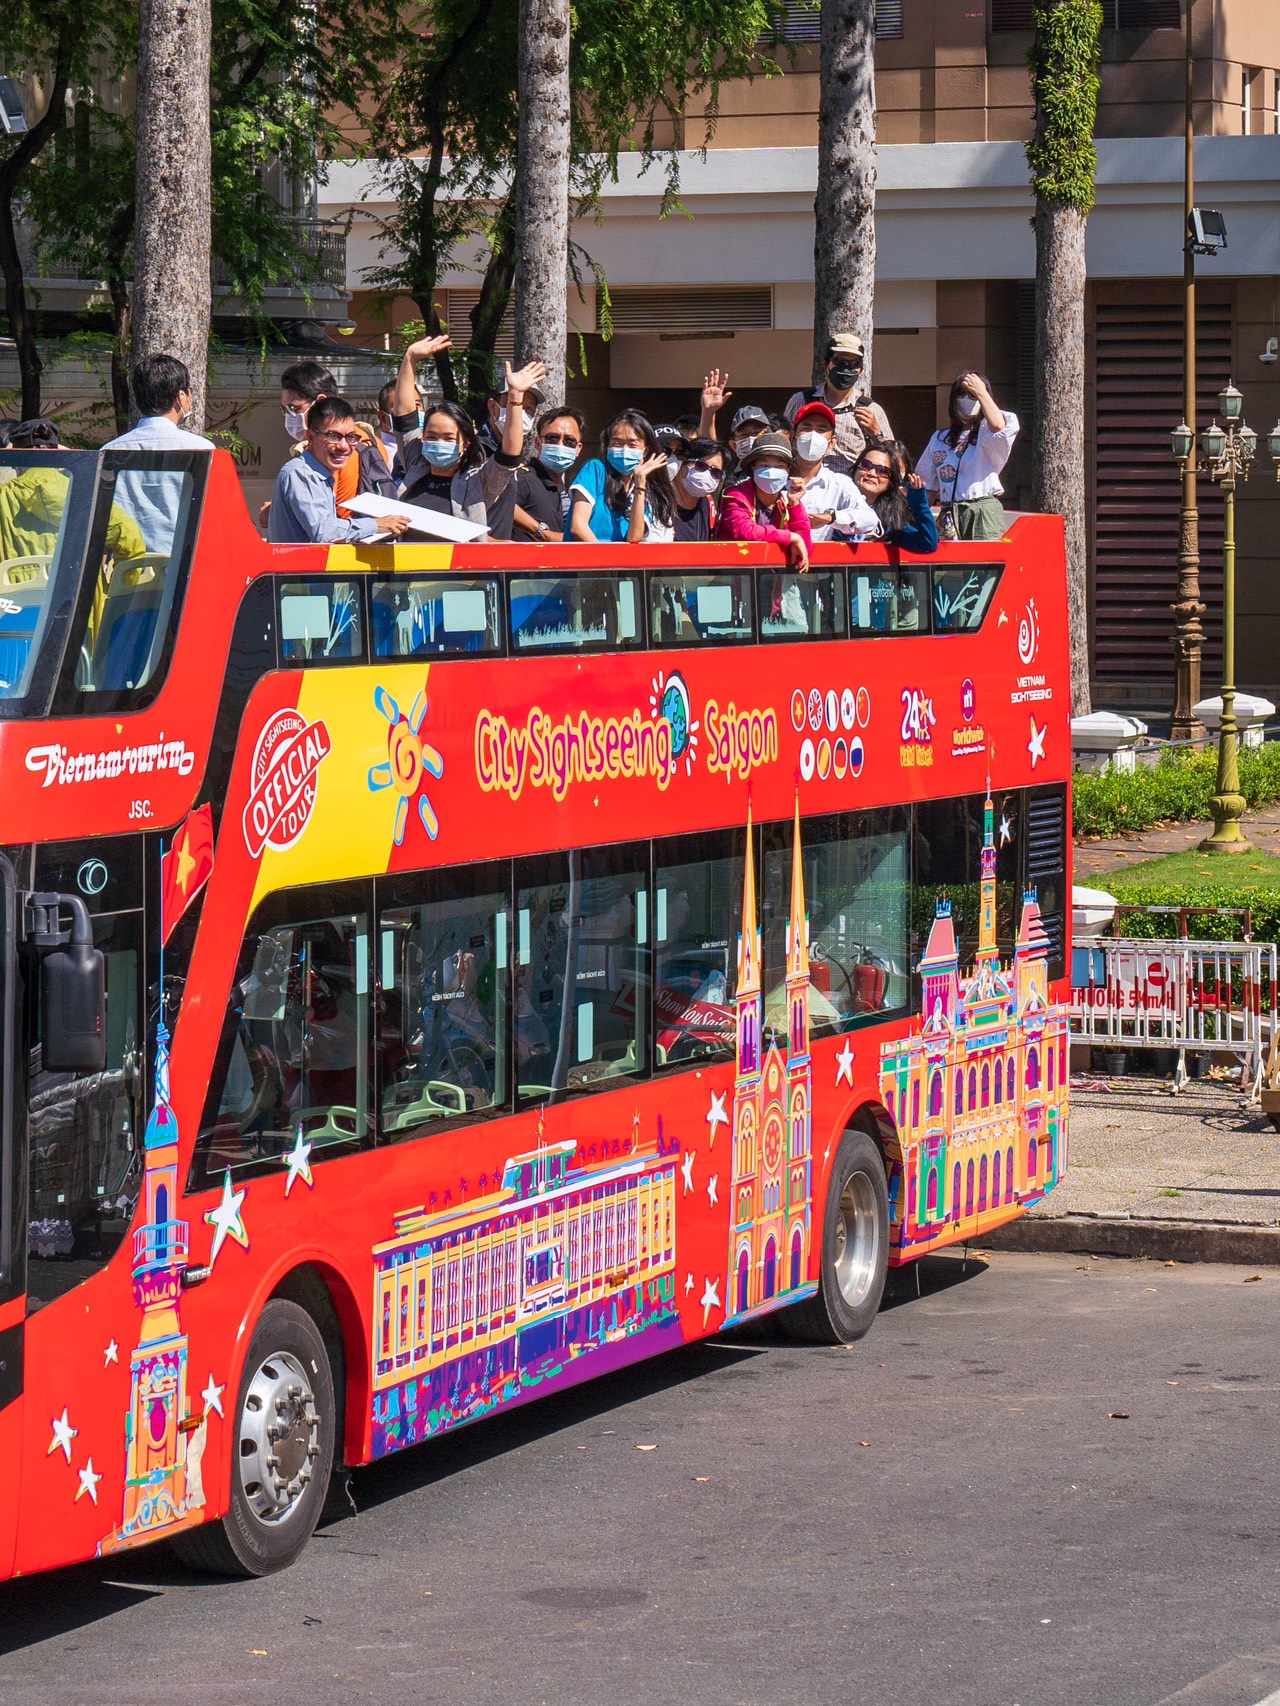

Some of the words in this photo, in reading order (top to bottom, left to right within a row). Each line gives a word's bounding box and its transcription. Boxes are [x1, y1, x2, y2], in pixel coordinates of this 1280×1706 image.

[1016, 674, 1046, 688] VIETNAM
[25, 731, 195, 788] Vietnamtourism
[256, 747, 269, 779] CITY
[264, 718, 303, 752] SIGHTSEEING
[704, 699, 778, 780] Saigon
[128, 799, 154, 819] JSC.
[252, 727, 327, 837] OFFICIAL
[281, 784, 315, 839] TOUR
